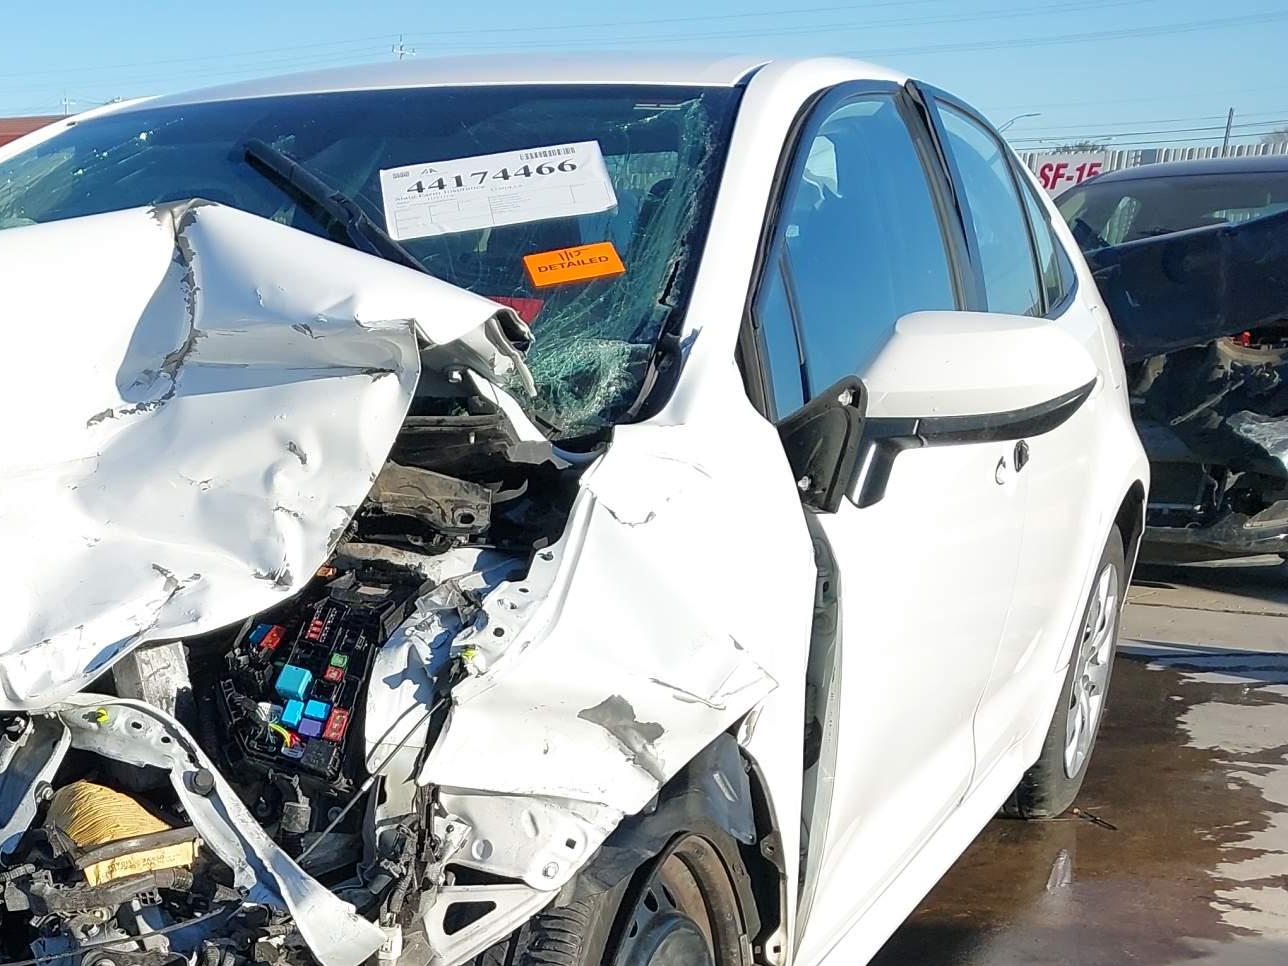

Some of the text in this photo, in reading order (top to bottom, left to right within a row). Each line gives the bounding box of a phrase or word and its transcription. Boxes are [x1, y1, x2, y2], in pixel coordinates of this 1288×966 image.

[407, 158, 578, 194] 44174466
[1039, 162, 1102, 190] SF-15
[537, 255, 609, 273] DETAILED
